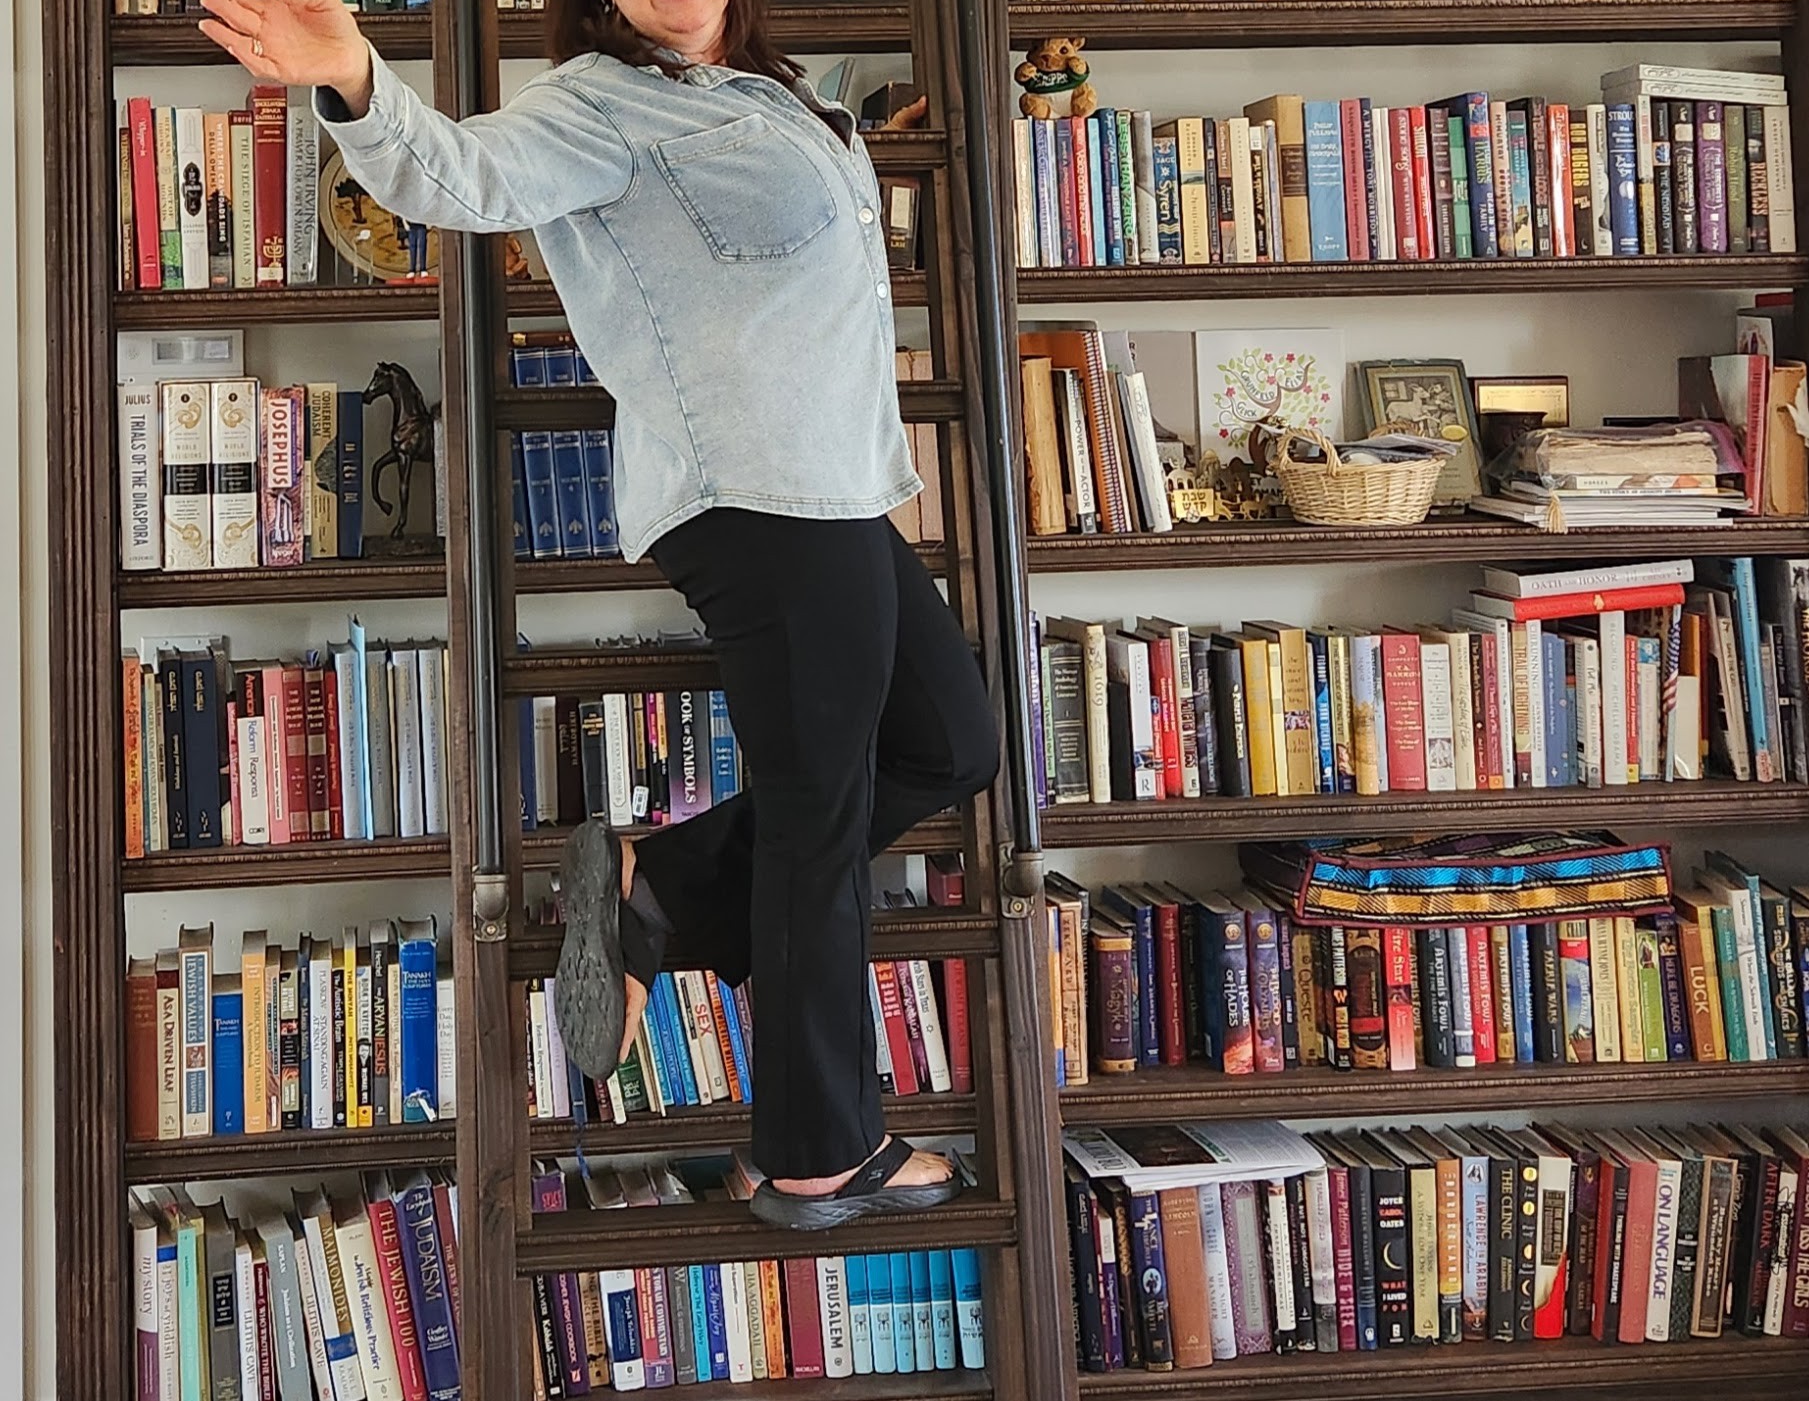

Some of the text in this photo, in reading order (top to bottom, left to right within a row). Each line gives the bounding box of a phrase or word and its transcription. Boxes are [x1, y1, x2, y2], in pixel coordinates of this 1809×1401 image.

[304, 140, 316, 235] JOHN IRVING
[1117, 115, 1134, 238] LESS THAN ZERO
[1474, 141, 1486, 184] HARRIS
[1571, 147, 1589, 187] ROGERS
[1750, 162, 1768, 216] RECKLESS
[241, 137, 251, 265] THE SIEGE ISFAHAN
[1157, 180, 1172, 221] Syren
[1368, 193, 1376, 236] MORRISON
[125, 394, 151, 405] JULIUS
[312, 393, 321, 436] JUDAISM
[321, 390, 331, 439] COHERENT
[271, 401, 288, 485] JOSEPHUS
[1074, 419, 1091, 508] POWER ACTOR
[130, 414, 148, 546] TRIALS OF THE DIASPORA
[1182, 492, 1205, 501] שבת
[1182, 502, 1207, 512] קדש
[1532, 574, 1618, 590] OATH HONOR
[1092, 675, 1104, 707] 1619
[1515, 647, 1529, 735] TRAIL OF LIGHTNING
[1612, 684, 1621, 728] MICHELLE
[247, 720, 258, 753] Reform
[682, 735, 696, 804] SYMBOLS
[186, 957, 199, 1041] JEWISH VALUES
[1224, 982, 1238, 1026] HADES
[1239, 985, 1249, 1026] HOUSE
[1298, 969, 1313, 1021] Queste
[1434, 948, 1448, 1031] ARTEMIS FOWL
[1477, 941, 1491, 1025] ARTEMIS FOWL
[1666, 957, 1681, 1033] HERE DRAGONS
[1690, 966, 1709, 1015] LUCK
[335, 1020, 344, 1042] Brain
[373, 996, 385, 1037] ARYAN
[695, 1004, 712, 1037] SEX
[164, 1021, 175, 1093] DRIVEN LEAF
[320, 1015, 329, 1090] STANDING AGAIN
[375, 1037, 386, 1075] JESUS
[1379, 1196, 1403, 1205] JOYCE
[1379, 1219, 1404, 1228] OATES
[1500, 1168, 1514, 1240] THE CLINIC
[1760, 1163, 1778, 1249] AFTER DARK
[408, 1215, 442, 1302] JUDAISM
[1334, 1171, 1355, 1328] James Patterson HIDE SEEK
[1446, 1180, 1457, 1284] BORDERLAND
[1475, 1194, 1488, 1300] LAWRENCE ARABIA
[1653, 1184, 1673, 1300] ON LANGUAGE
[1706, 1215, 1718, 1296] Wounded Knee
[1712, 1207, 1726, 1290] Bury Heart
[139, 1280, 153, 1315] story
[321, 1226, 348, 1322] MAIMONIDES
[378, 1207, 415, 1347] THE JEWISH 100
[592, 1296, 603, 1346] THE BIBLE
[653, 1274, 666, 1356] TORAH COMMENTARY
[825, 1267, 844, 1349] JERUSALEM
[159, 1315, 175, 1360] yiddish
[565, 1323, 577, 1363] COOKBOOK
